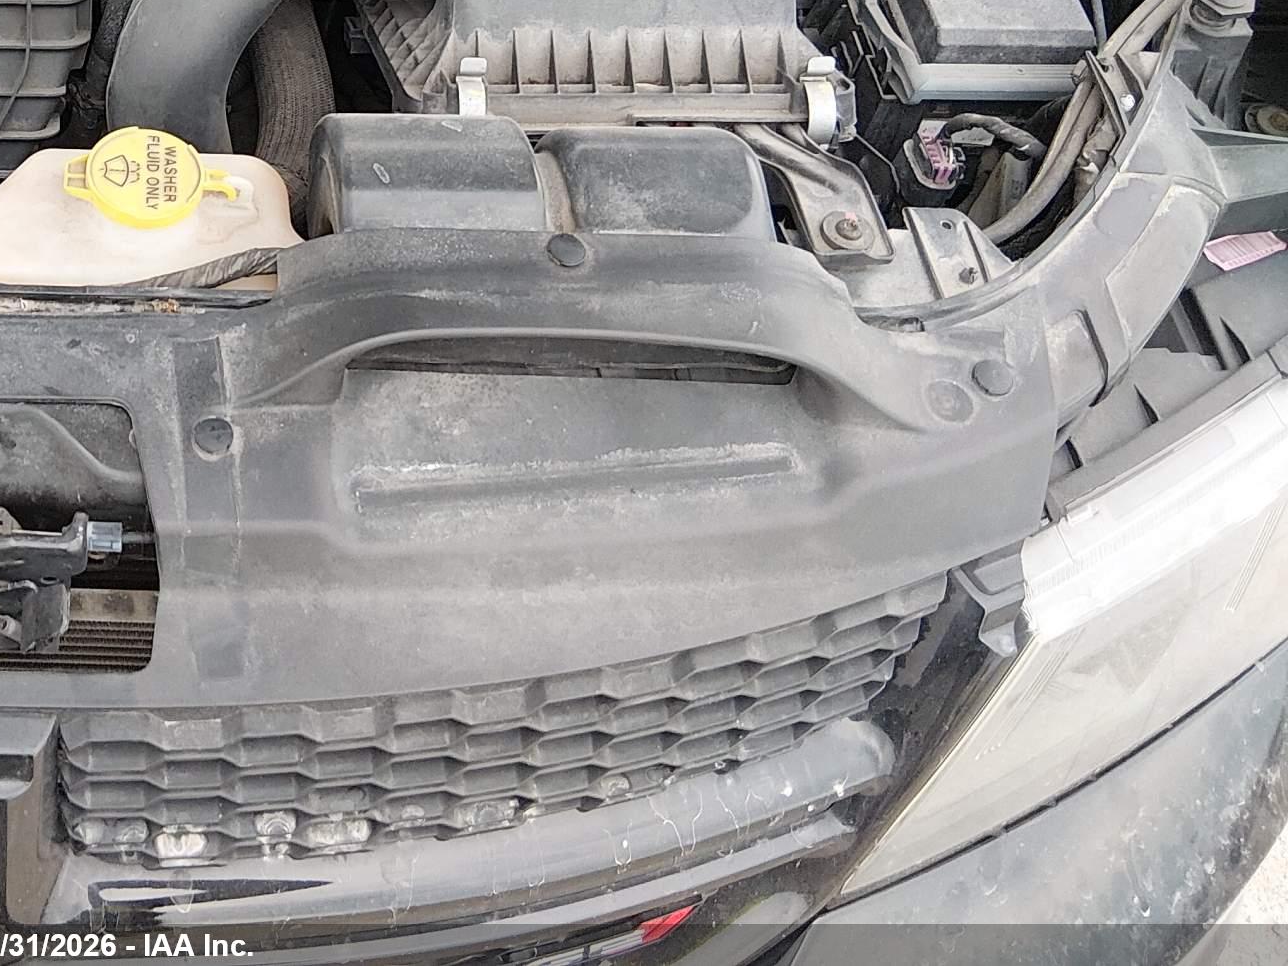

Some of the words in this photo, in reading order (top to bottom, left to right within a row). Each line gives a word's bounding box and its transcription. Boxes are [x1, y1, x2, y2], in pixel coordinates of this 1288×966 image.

[146, 134, 161, 173] FLUID
[145, 177, 160, 210] ONLY
[163, 145, 178, 203] WASHER
